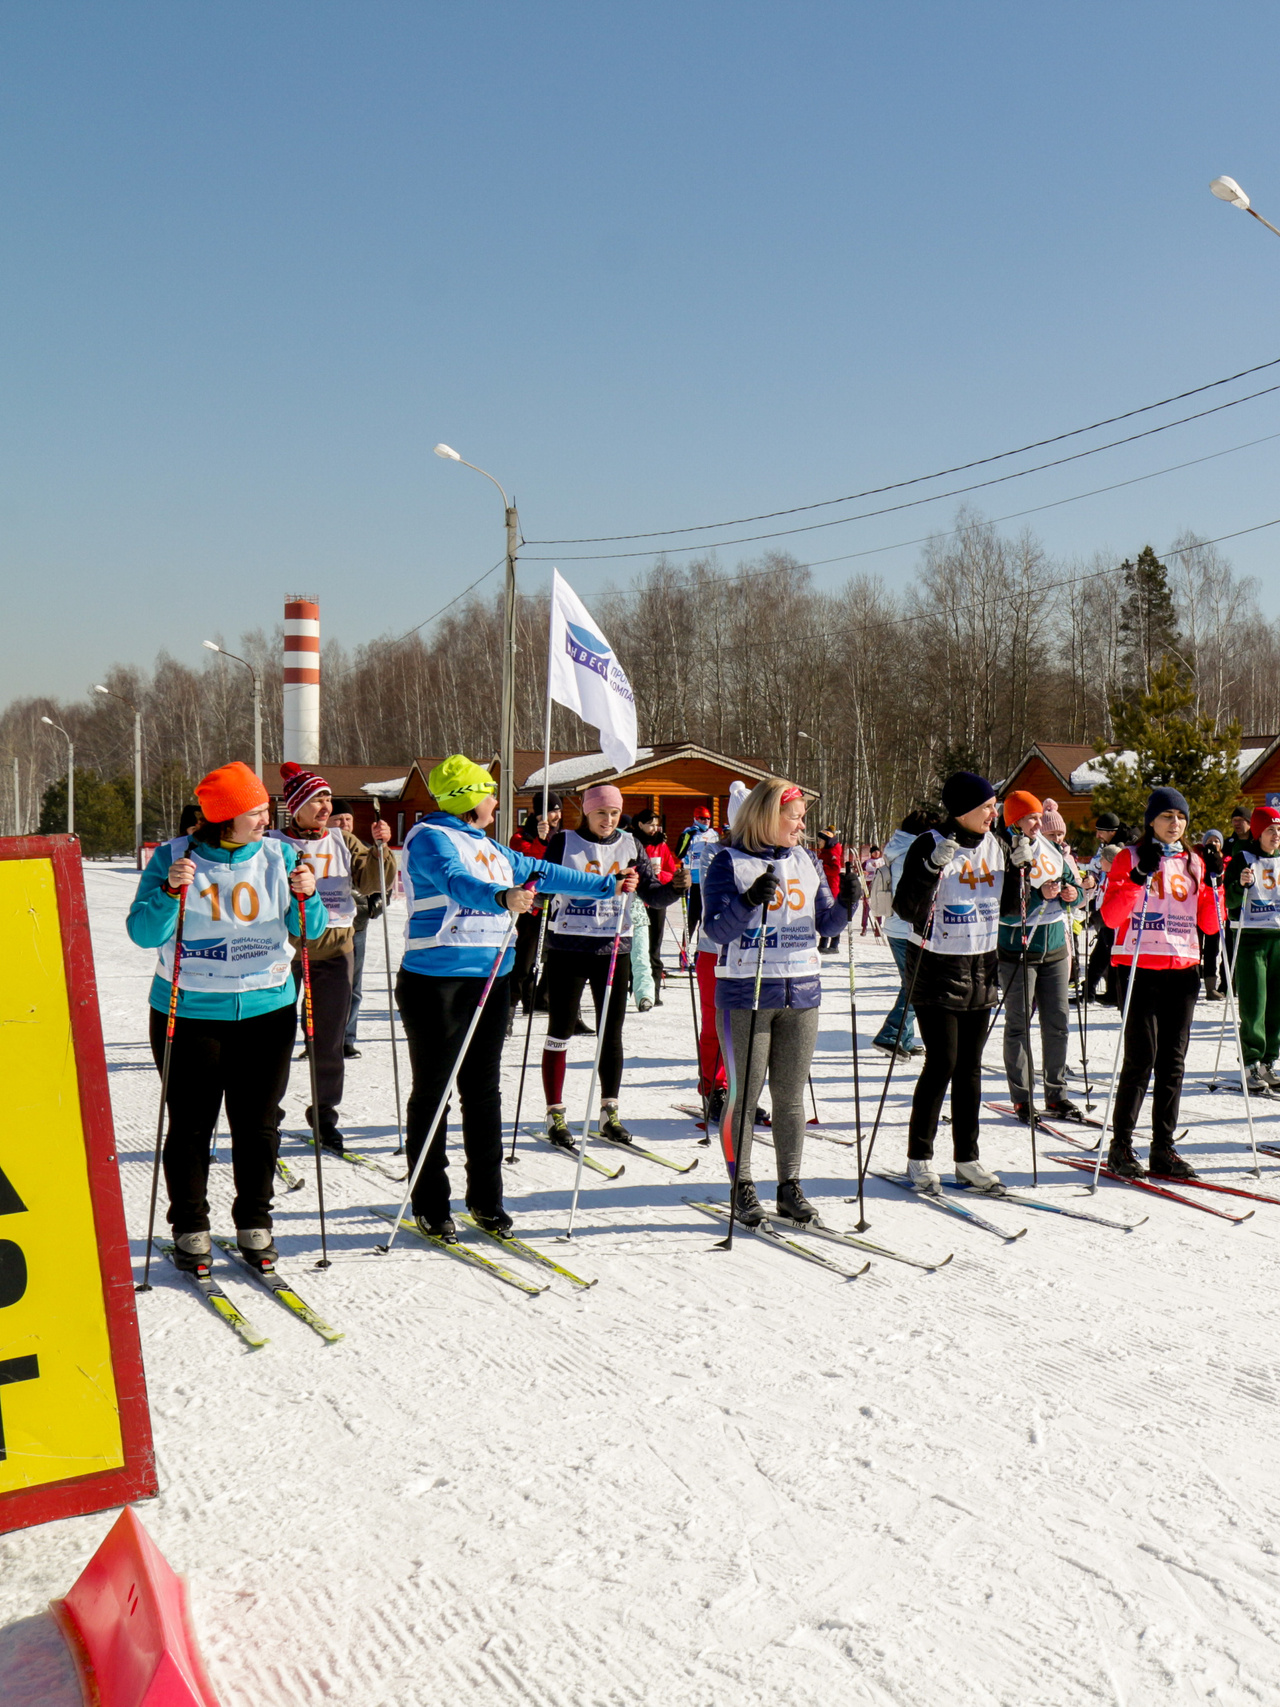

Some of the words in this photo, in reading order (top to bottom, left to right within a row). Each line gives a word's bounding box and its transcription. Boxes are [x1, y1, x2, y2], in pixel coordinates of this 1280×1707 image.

[958, 858, 995, 890] 44
[1152, 871, 1188, 902] 16
[199, 881, 260, 922] 10
[944, 915, 976, 923] ИНВЕСТ
[780, 941, 808, 949] КОМПАНИЯ
[231, 950, 269, 962] КОМПАНИЯ
[547, 1040, 567, 1049] SPORT
